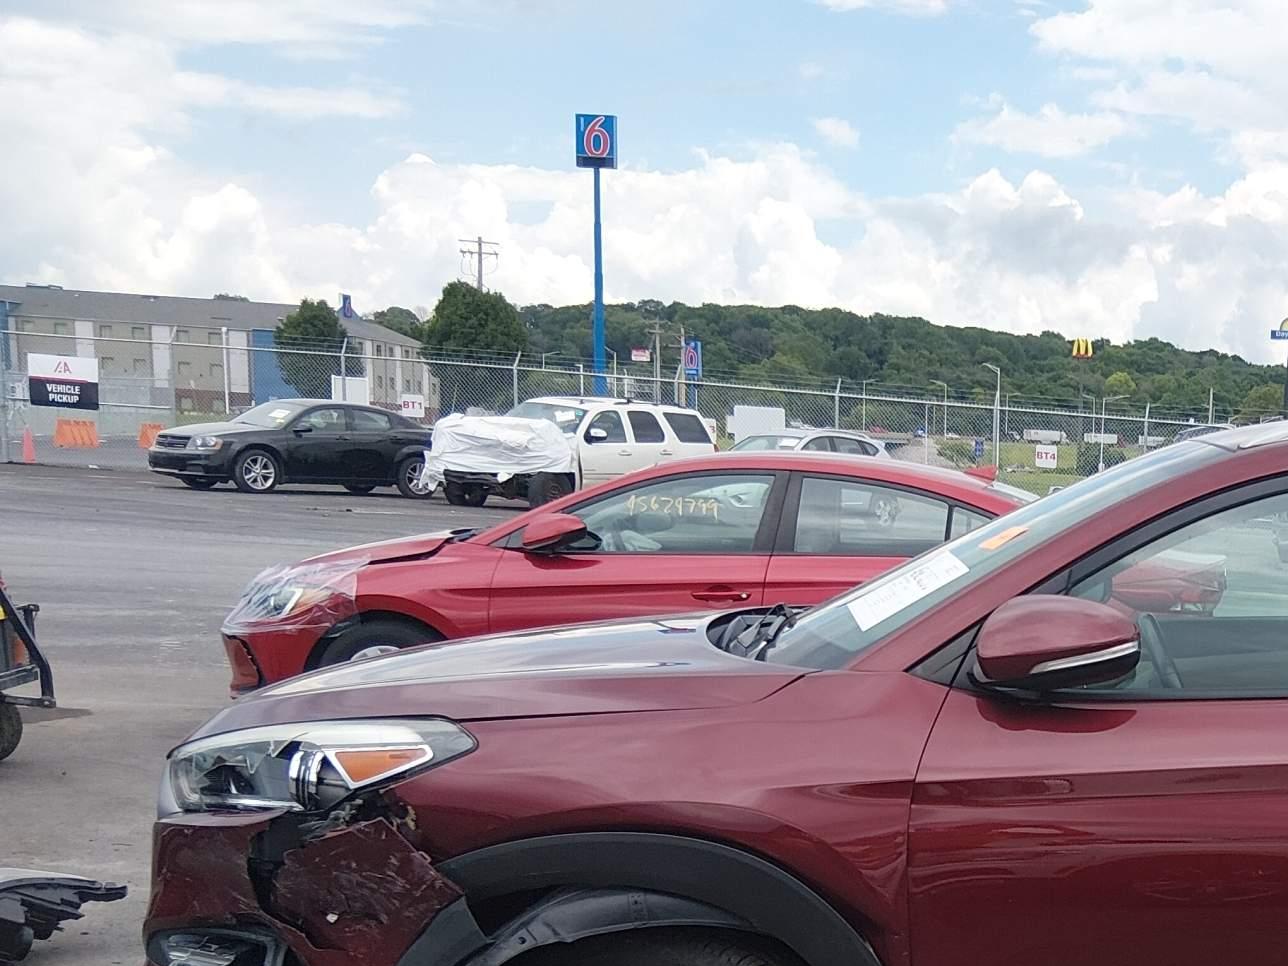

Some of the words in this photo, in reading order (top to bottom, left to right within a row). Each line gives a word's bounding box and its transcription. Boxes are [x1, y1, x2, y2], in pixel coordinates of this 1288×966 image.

[583, 115, 610, 157] 6
[46, 384, 80, 394] VEHICLE
[48, 394, 79, 403] PICKUP
[1036, 451, 1056, 460] BT4
